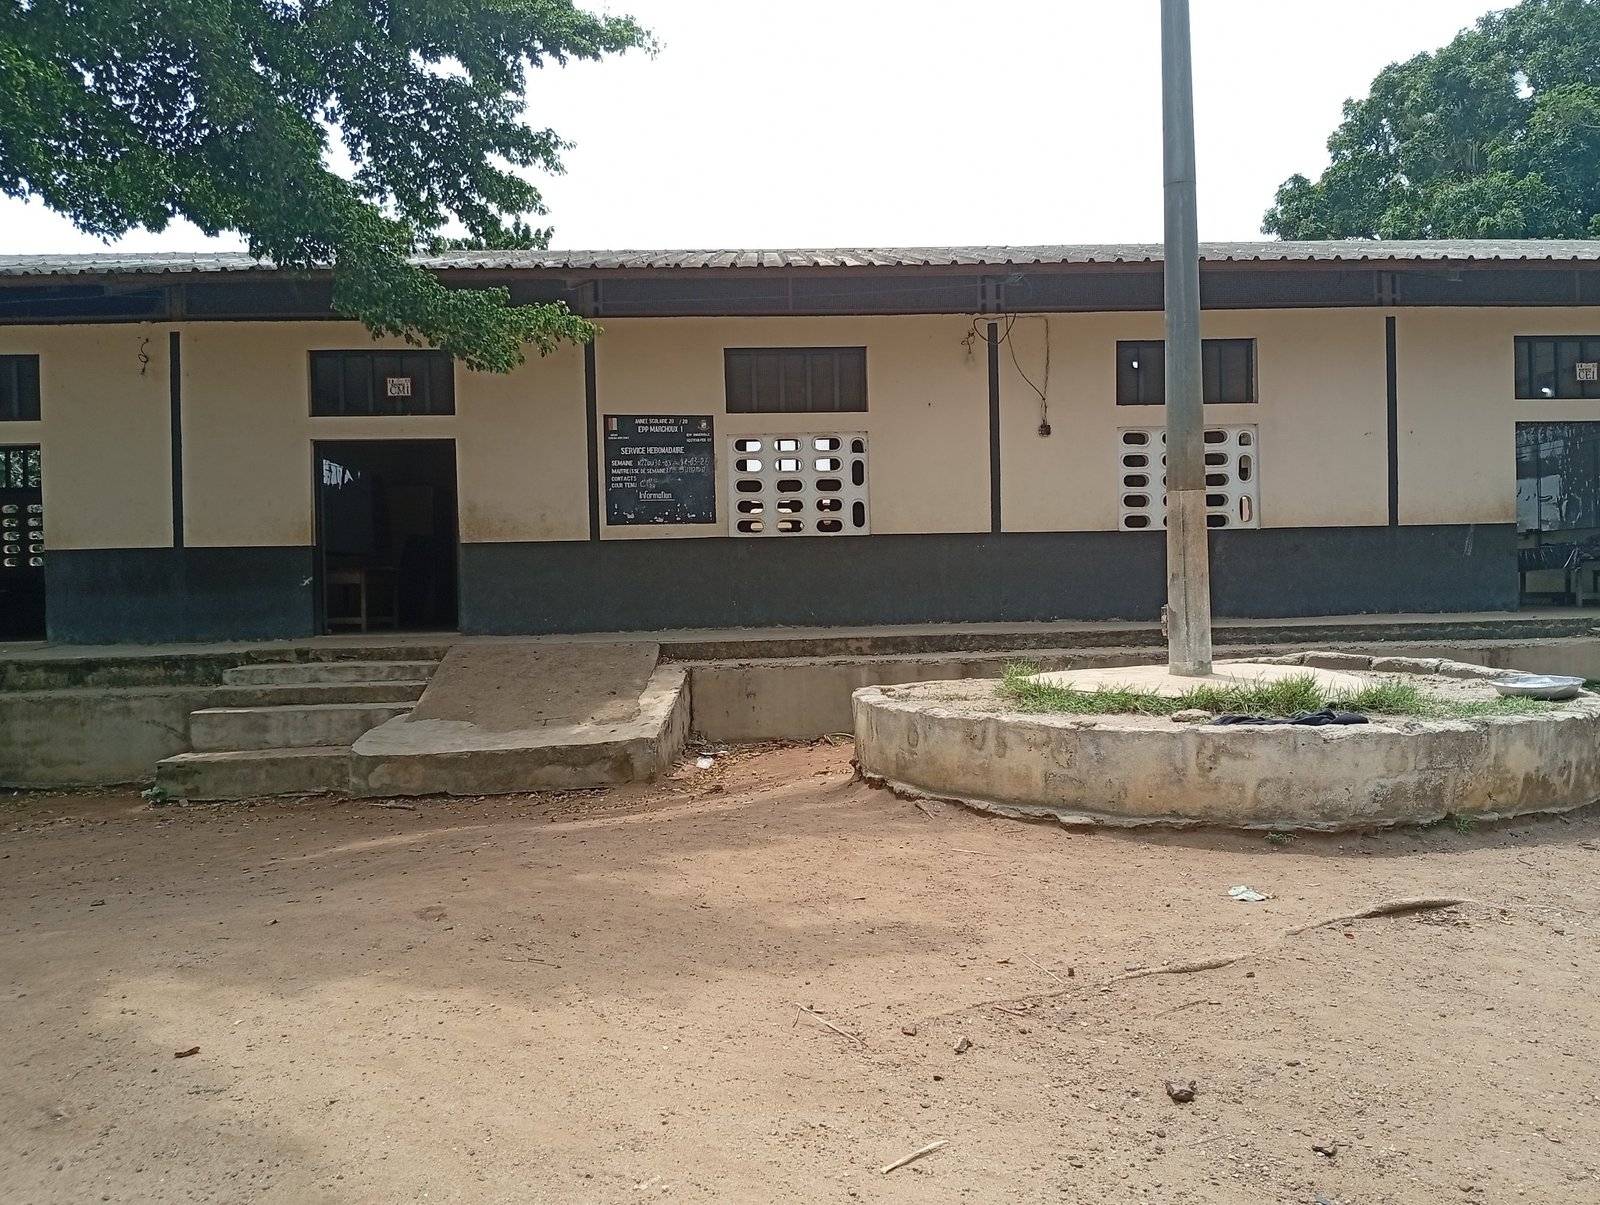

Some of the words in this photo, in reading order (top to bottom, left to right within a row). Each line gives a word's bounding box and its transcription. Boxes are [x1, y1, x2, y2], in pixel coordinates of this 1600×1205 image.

[637, 425, 650, 433] EPP
[620, 446, 646, 455] SERVICE
[639, 490, 672, 499] Information
